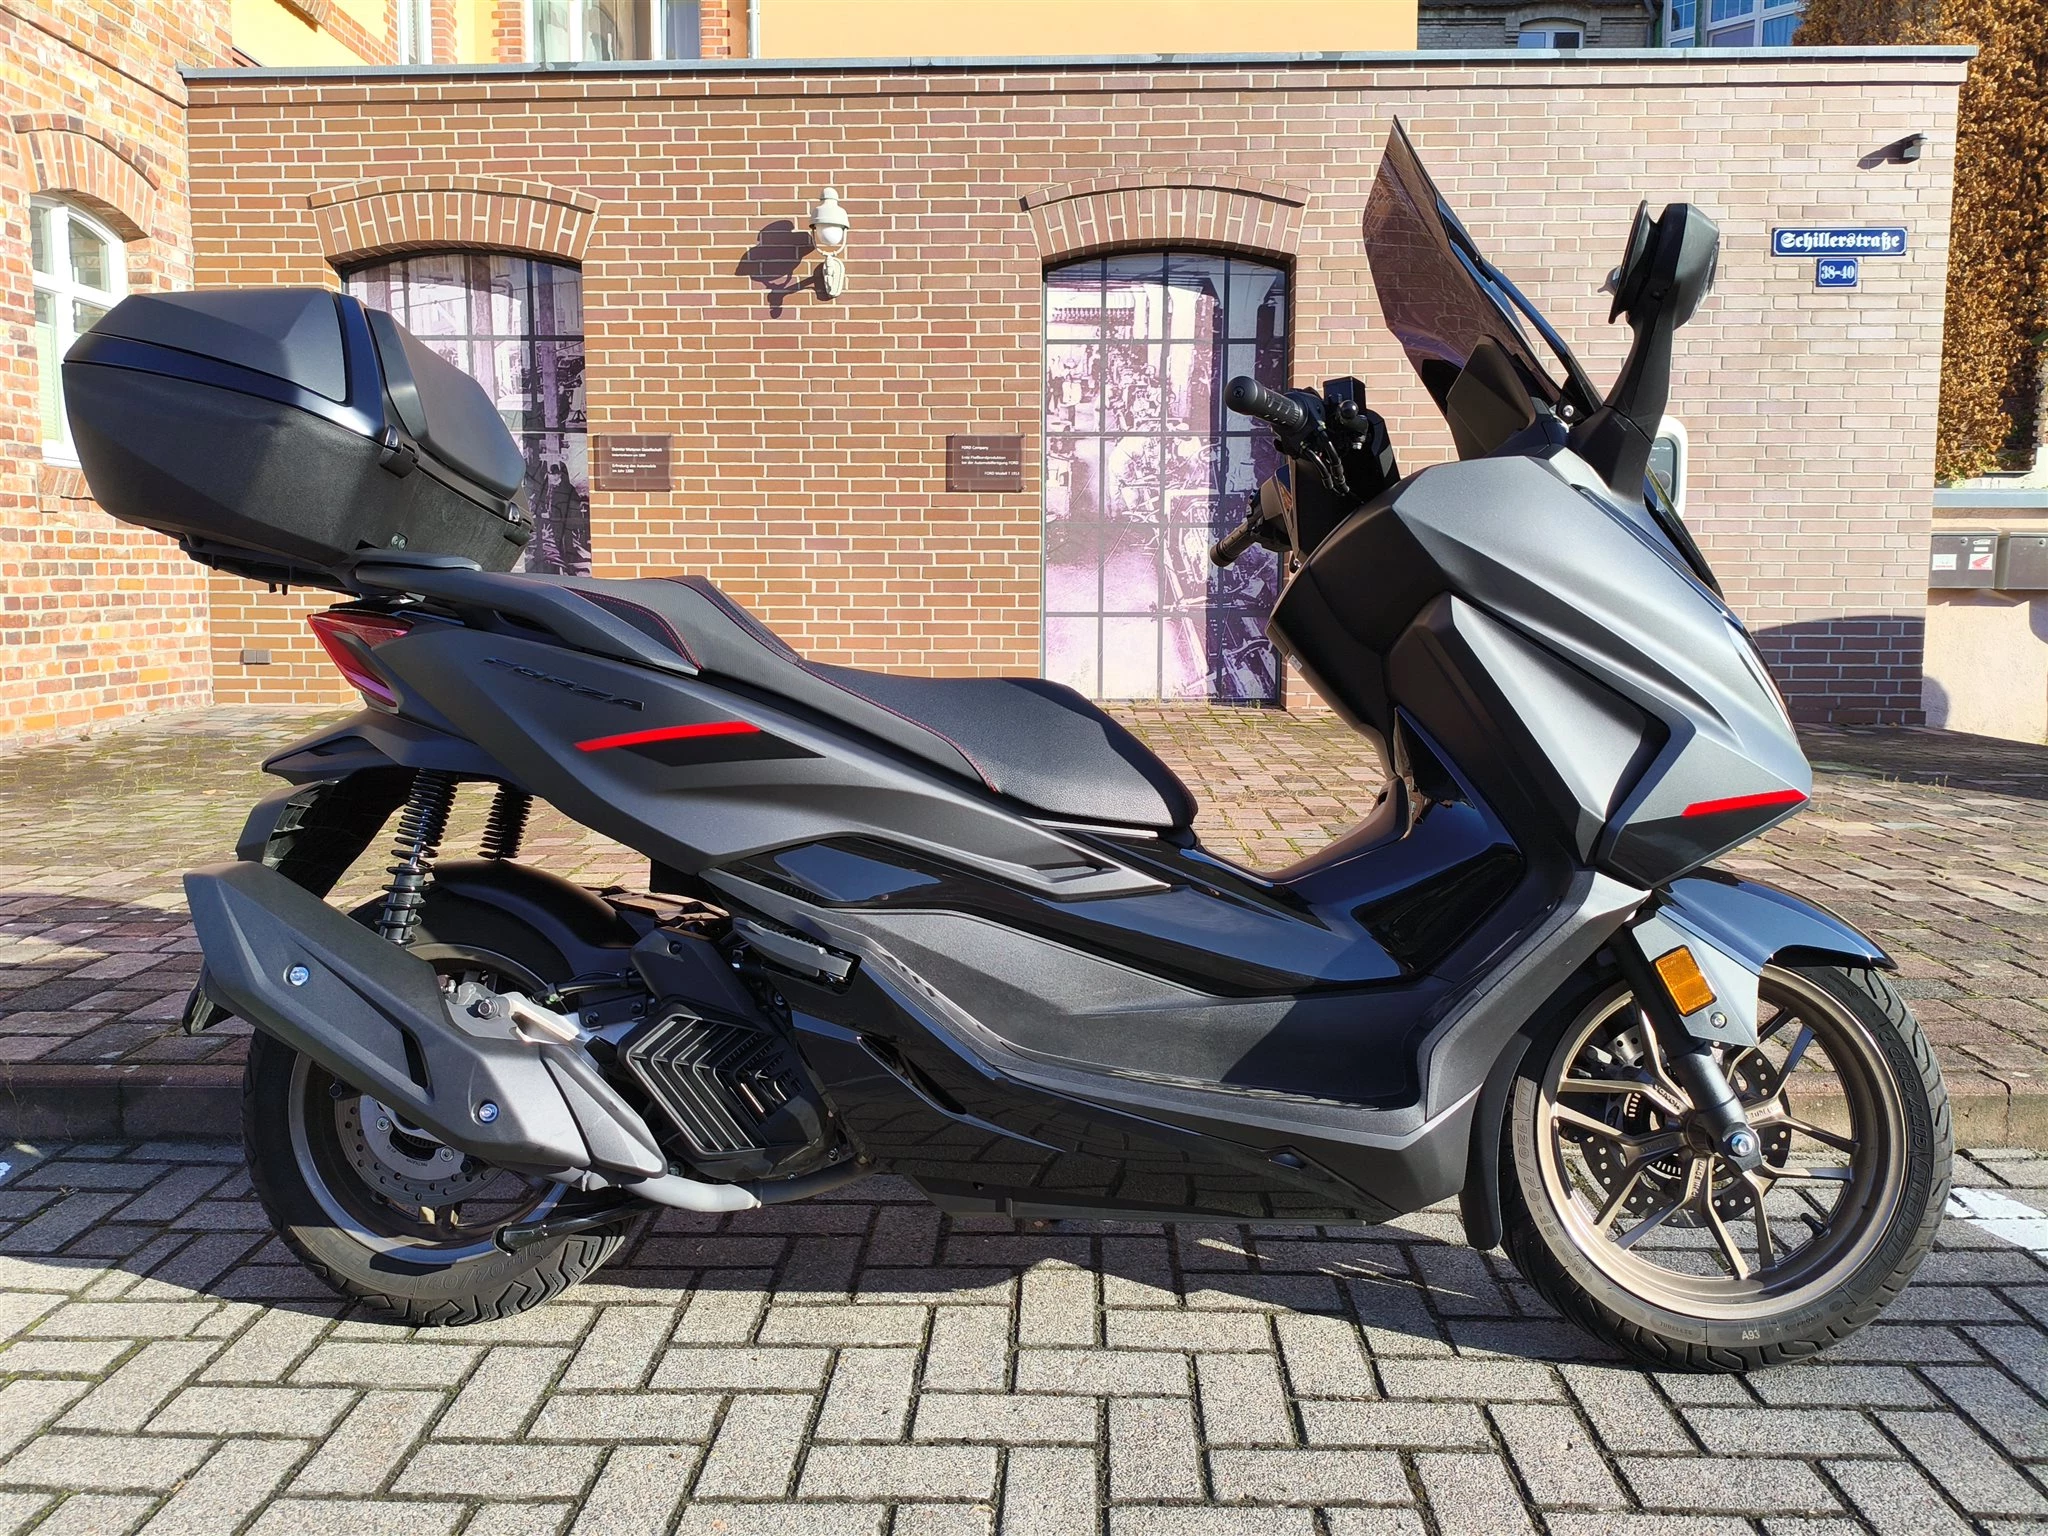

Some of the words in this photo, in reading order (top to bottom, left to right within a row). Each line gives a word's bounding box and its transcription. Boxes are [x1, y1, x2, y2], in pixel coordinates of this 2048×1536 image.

[1780, 232, 1900, 251] Schillerstraße
[1821, 265, 1855, 279] 38-40
[1741, 1329, 1761, 1341] A93
